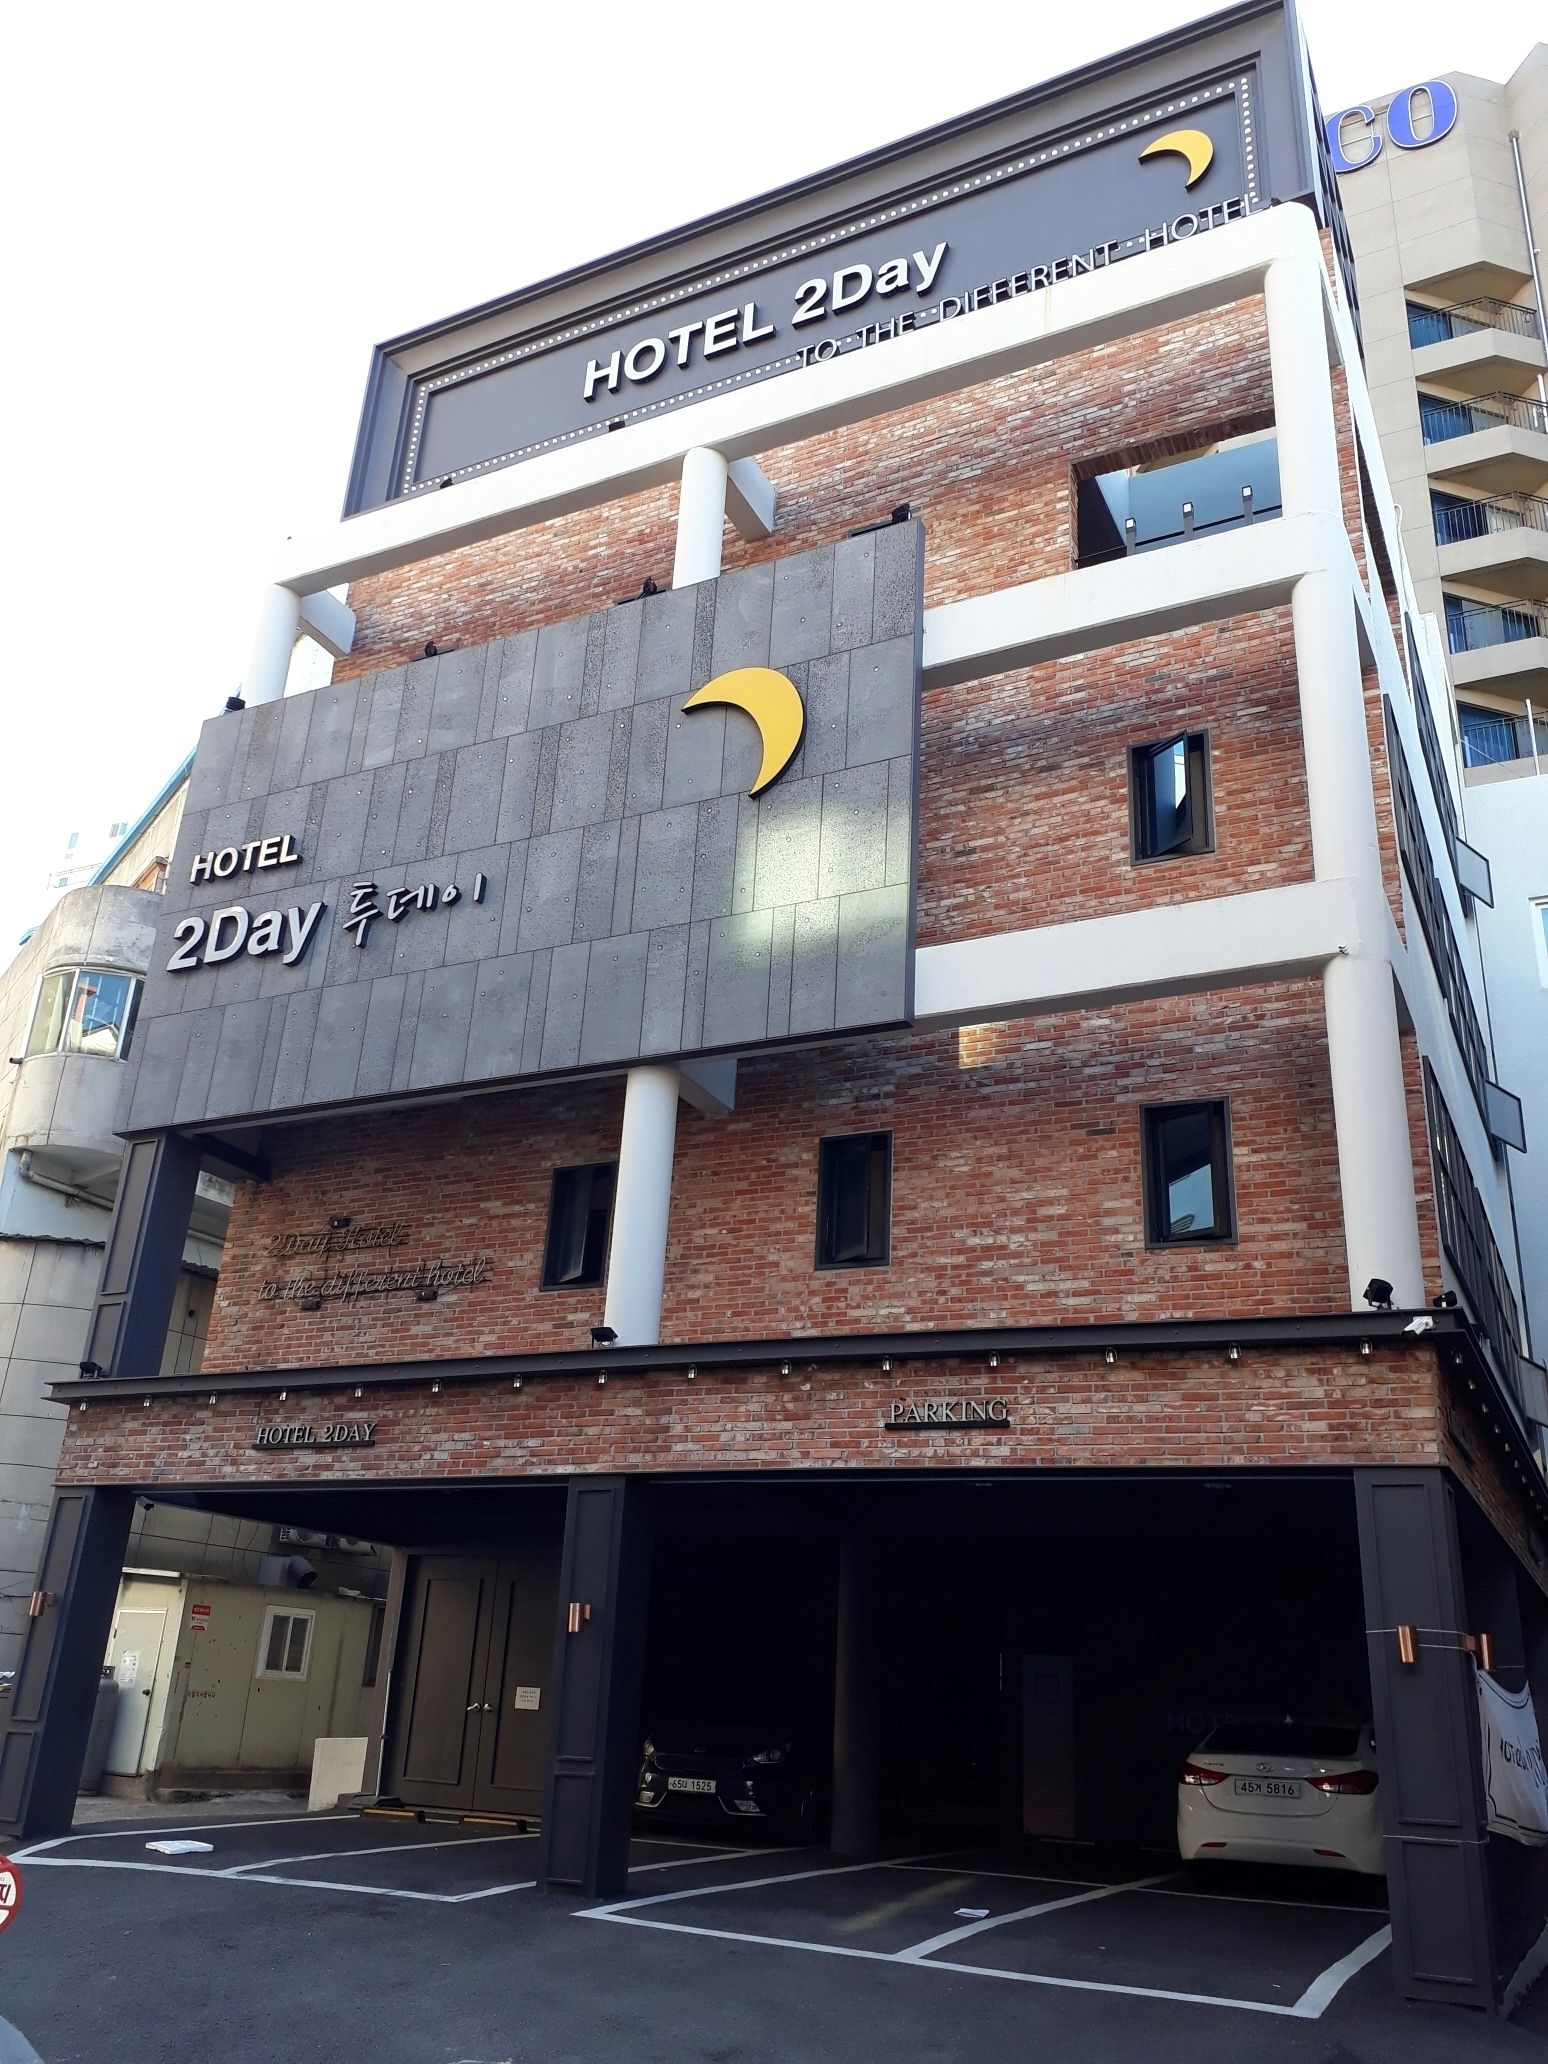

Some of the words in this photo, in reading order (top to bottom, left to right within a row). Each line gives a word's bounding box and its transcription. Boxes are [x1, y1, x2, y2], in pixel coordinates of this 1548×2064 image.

[797, 337, 838, 368] TO
[856, 311, 915, 348] THE
[939, 239, 1117, 322] DIFFERENT
[1145, 194, 1264, 252] HOTEL
[583, 302, 776, 402] HOTEL
[792, 242, 949, 330] 2Day
[189, 834, 301, 886] HOTEL
[166, 901, 327, 974] 2Day
[343, 873, 487, 948] 투데이
[337, 1222, 403, 1250] Hotel
[258, 1280, 278, 1299] to
[283, 1274, 316, 1300] the
[321, 1266, 422, 1303] different
[426, 1256, 487, 1286] hotel
[889, 1399, 1010, 1424] PARKING
[256, 1426, 315, 1444] HOTEL
[323, 1424, 377, 1442] 2DAY
[691, 1780, 712, 1792] 1525
[1266, 1783, 1295, 1796] 5816
